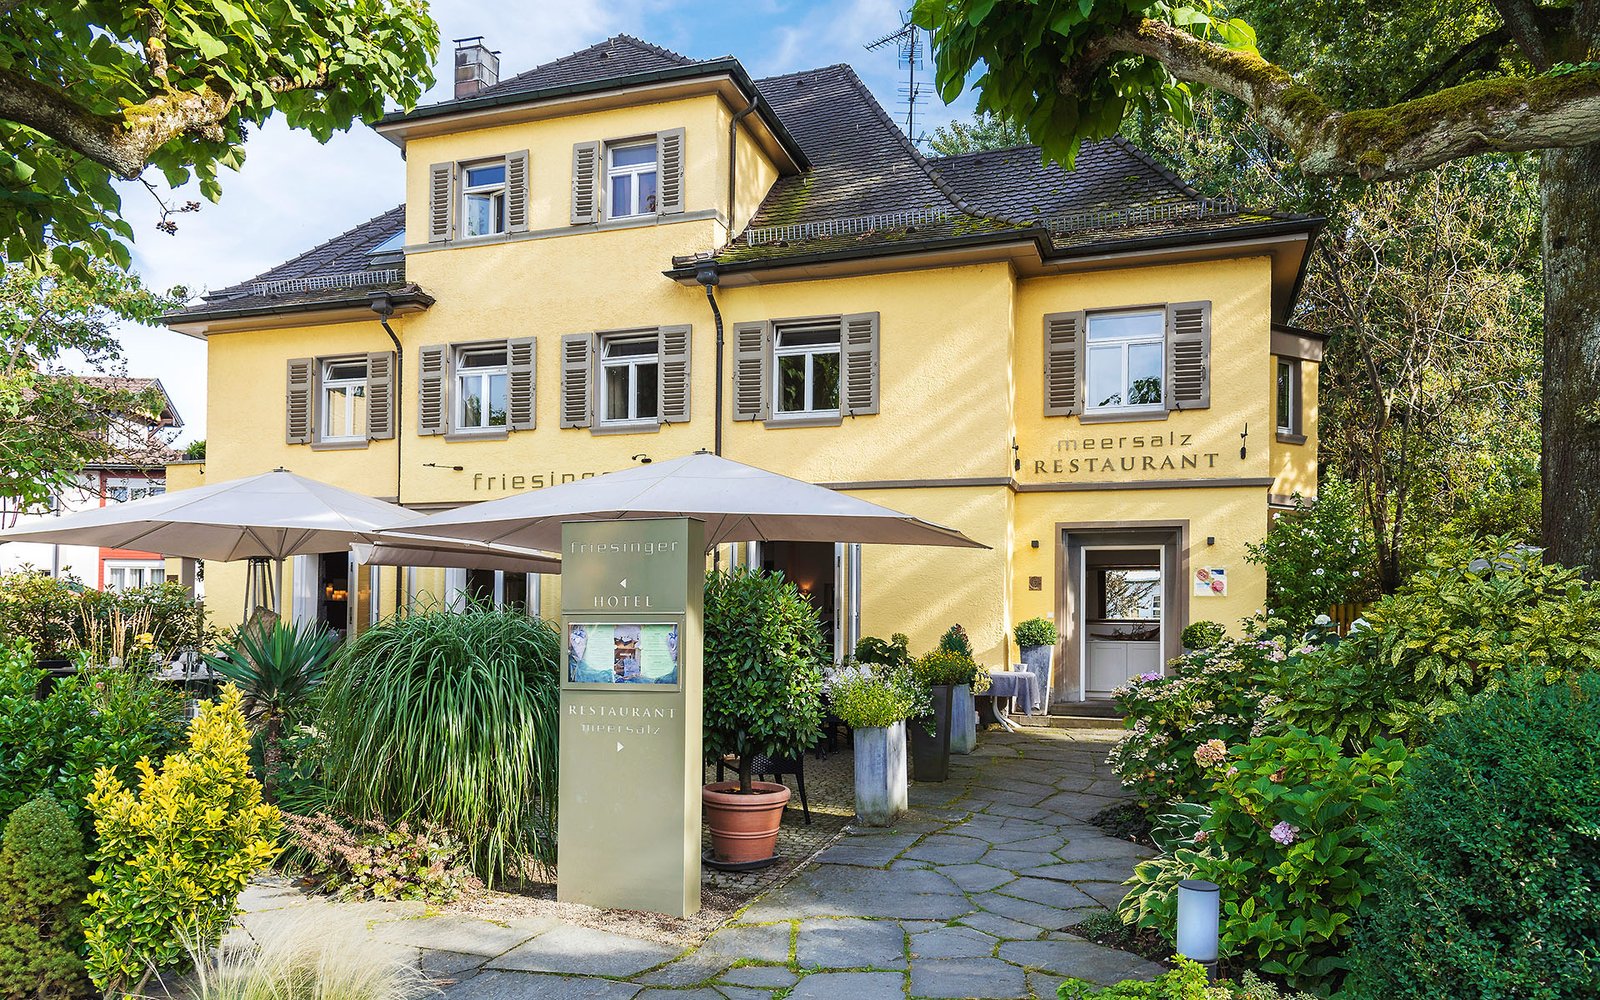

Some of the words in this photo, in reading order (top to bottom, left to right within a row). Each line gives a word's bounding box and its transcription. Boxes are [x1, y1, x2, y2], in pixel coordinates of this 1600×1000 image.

[1057, 431, 1193, 452] meersalz
[1035, 453, 1219, 474] RESTAURANT
[570, 540, 679, 556] friesinger
[593, 595, 654, 608] HOTEL
[568, 704, 677, 719] RESTAURANT
[580, 723, 661, 736] meersalz
